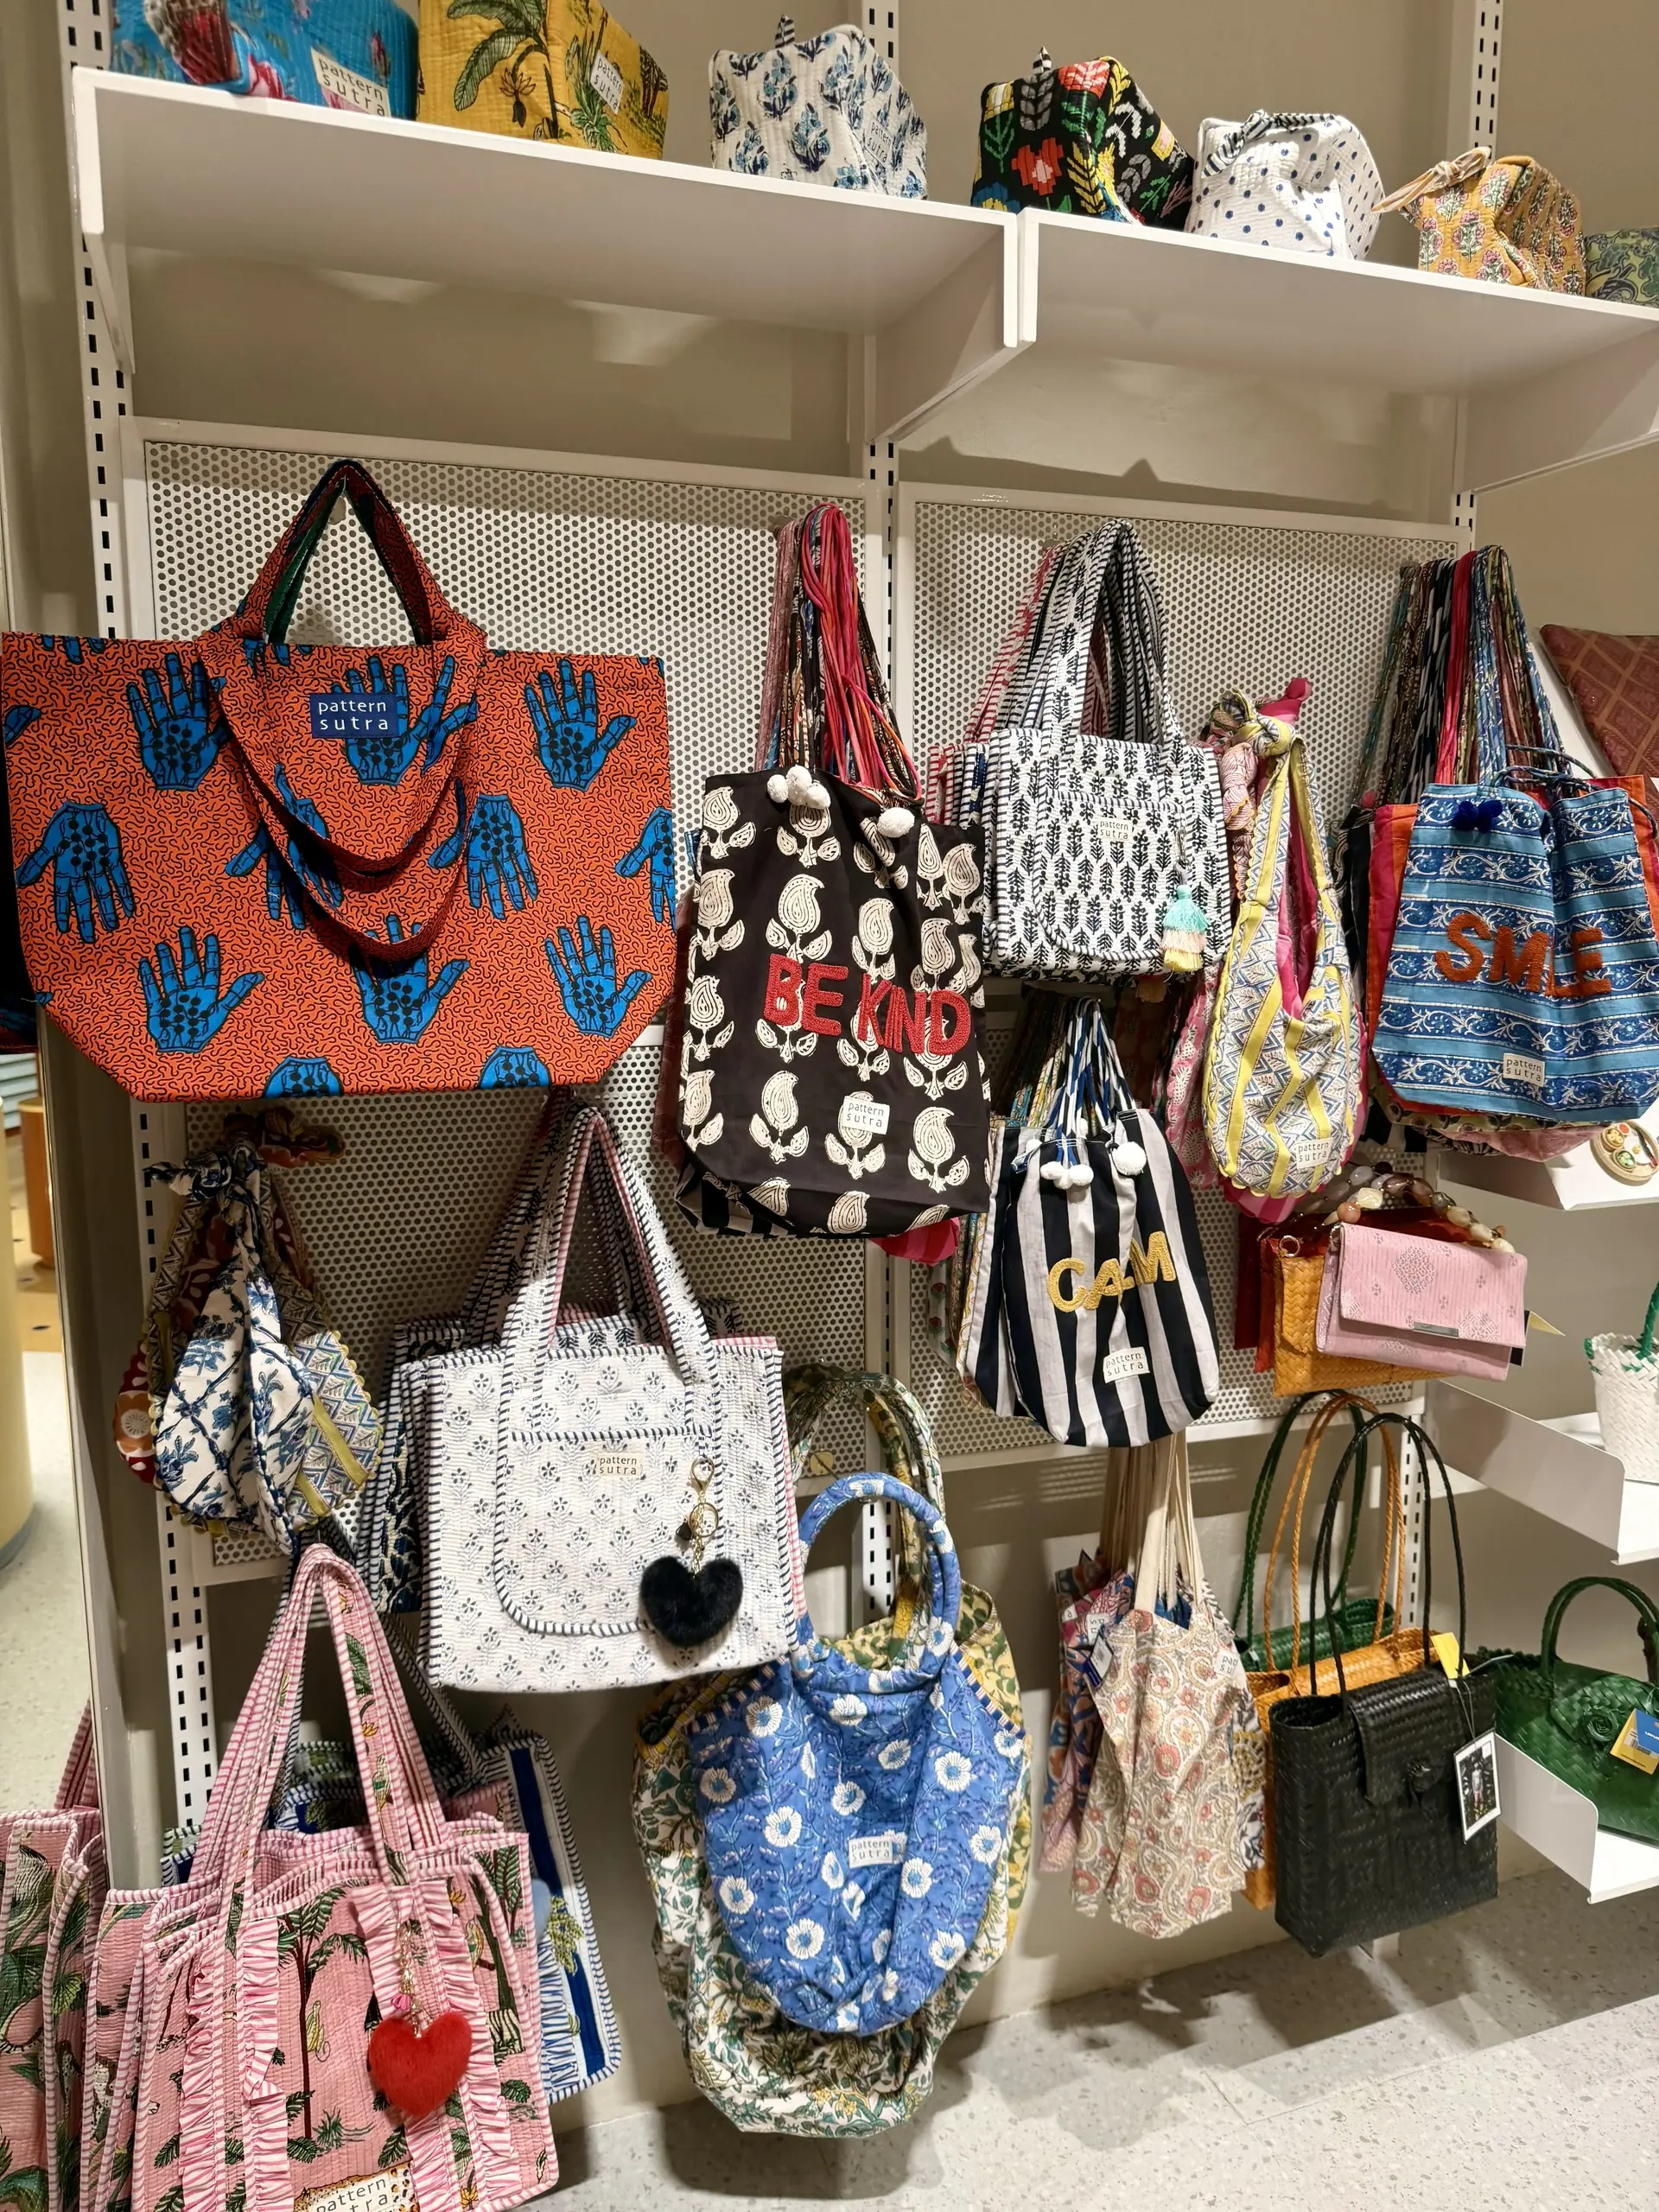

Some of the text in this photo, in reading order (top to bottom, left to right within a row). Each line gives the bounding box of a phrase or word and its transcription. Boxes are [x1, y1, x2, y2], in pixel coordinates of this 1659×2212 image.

[318, 58, 383, 101] pattern
[597, 58, 622, 94] pattern
[322, 74, 385, 117] sutra
[594, 74, 619, 110] sutra
[870, 121, 892, 146] pattern
[867, 137, 888, 162] sutra
[318, 700, 386, 715] pattern
[320, 716, 388, 731] sutra
[1100, 820, 1128, 830] pattern
[1099, 829, 1128, 840] sutra
[1434, 912, 1612, 998] SMLE
[763, 953, 849, 1037] BE
[1506, 1058, 1541, 1072] pattern
[1506, 1067, 1541, 1082] sutra
[848, 1103, 884, 1116] pattern
[846, 1113, 882, 1128] sutra
[1298, 1141, 1329, 1154] pattern
[1299, 1151, 1327, 1163] sutra
[1106, 1352, 1141, 1369] pattern
[1107, 1362, 1144, 1376] sutra
[600, 1456, 637, 1466] pattern
[599, 1465, 637, 1475] sutra
[851, 1840, 890, 1853] pattern
[852, 1849, 890, 1861] sutra
[349, 2194, 388, 2212] tra
